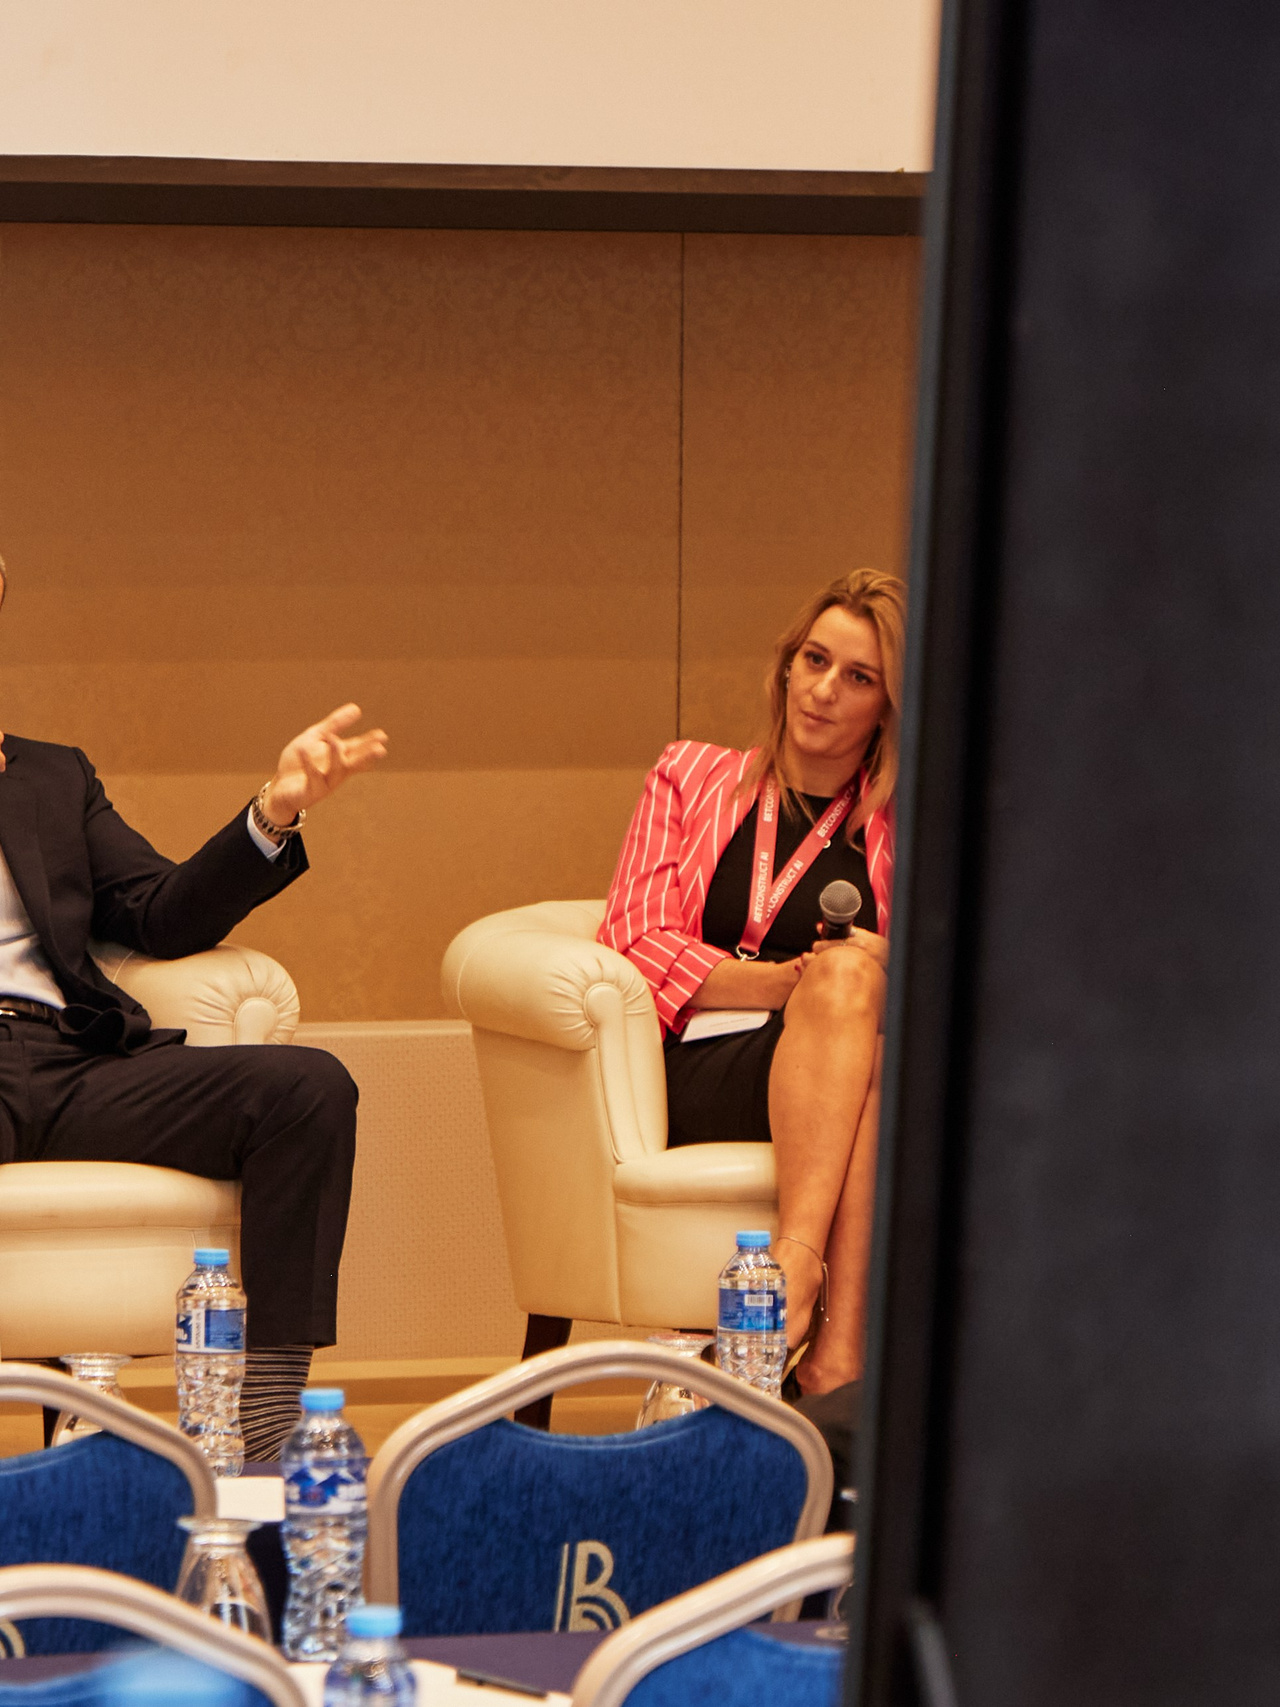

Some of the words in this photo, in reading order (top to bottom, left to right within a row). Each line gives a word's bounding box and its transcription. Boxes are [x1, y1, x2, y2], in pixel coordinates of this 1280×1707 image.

[760, 851, 769, 861] AI
[753, 861, 769, 923] BETCONSTRUCT
[766, 867, 798, 919] CONSTRUCT
[793, 859, 804, 870] AI
